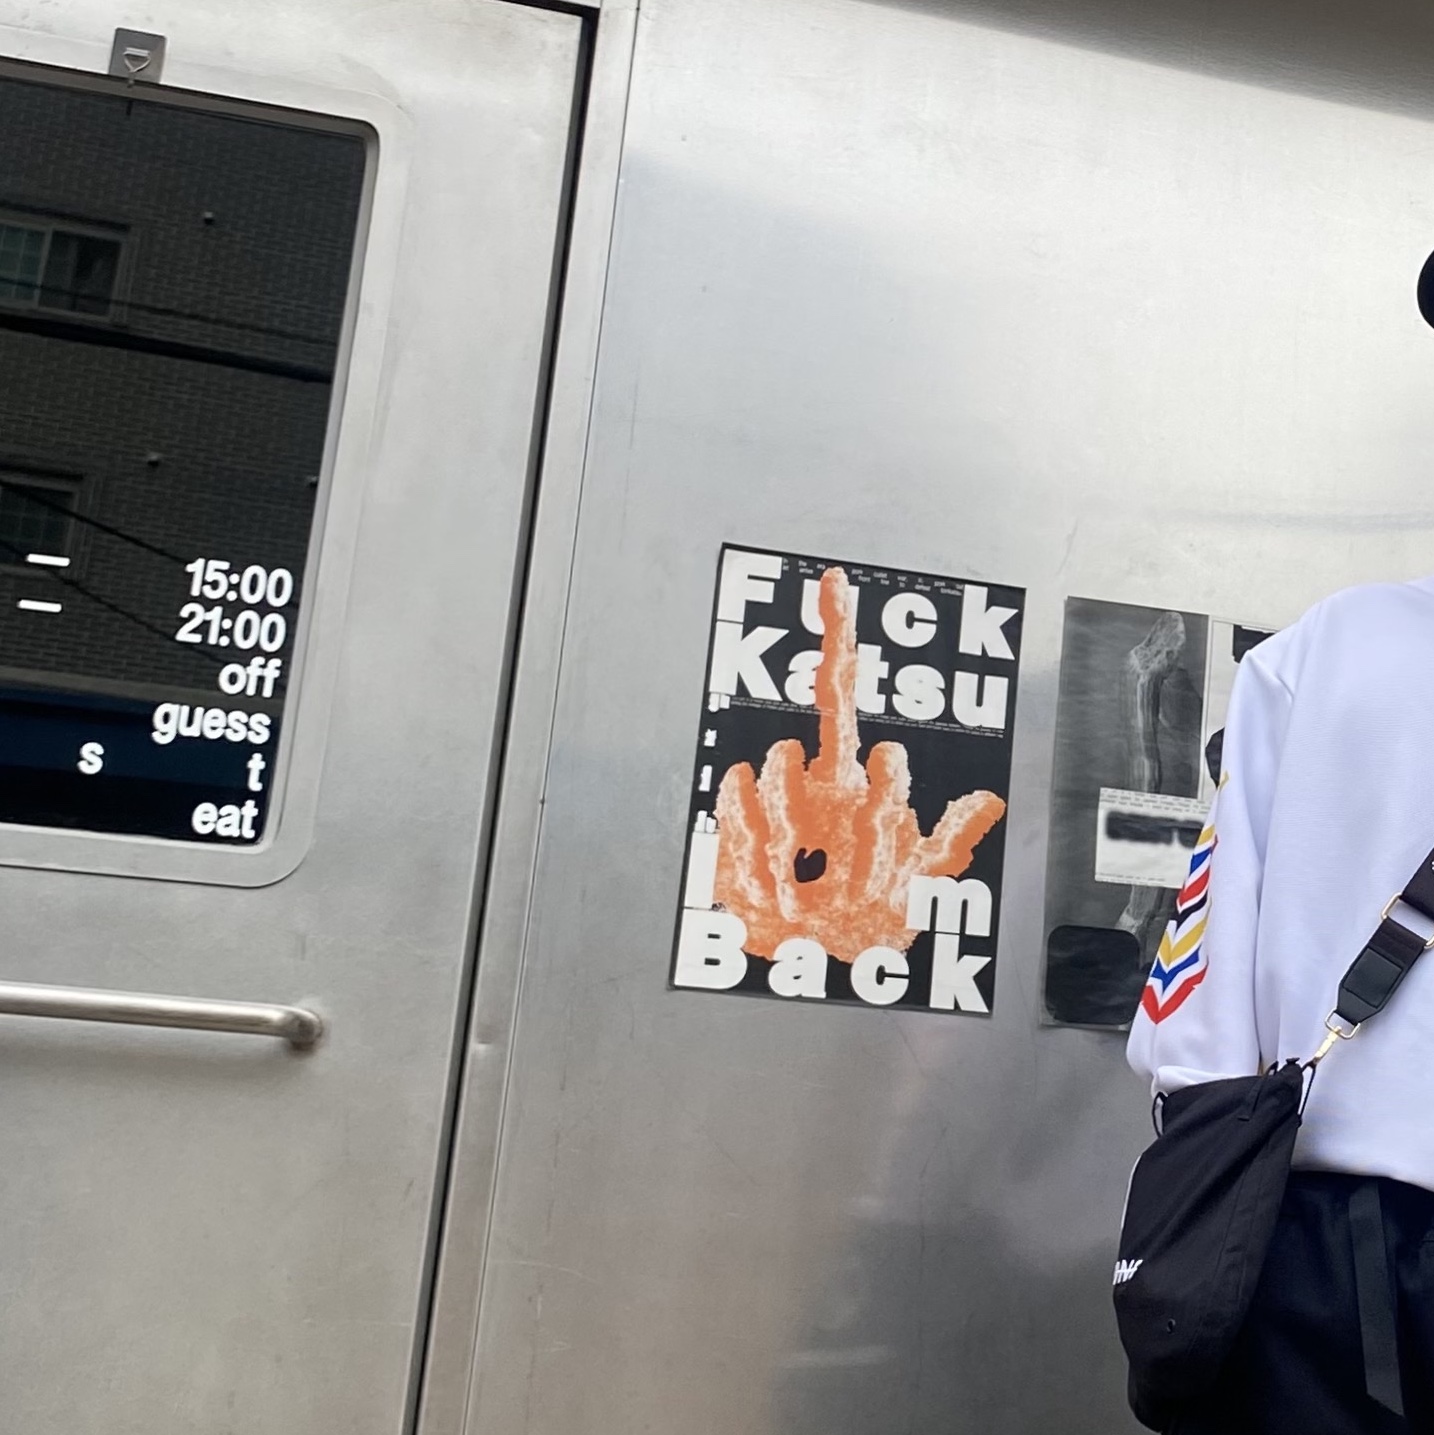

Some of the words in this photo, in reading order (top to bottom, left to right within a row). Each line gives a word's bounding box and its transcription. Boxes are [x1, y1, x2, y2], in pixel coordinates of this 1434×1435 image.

[185, 558, 293, 607] 15:00
[174, 602, 287, 652] 21:00
[218, 656, 282, 698] off
[152, 702, 271, 745] guess
[78, 742, 104, 775] s
[247, 752, 266, 791] t
[191, 799, 259, 839] eat
[674, 908, 993, 1013] Back
